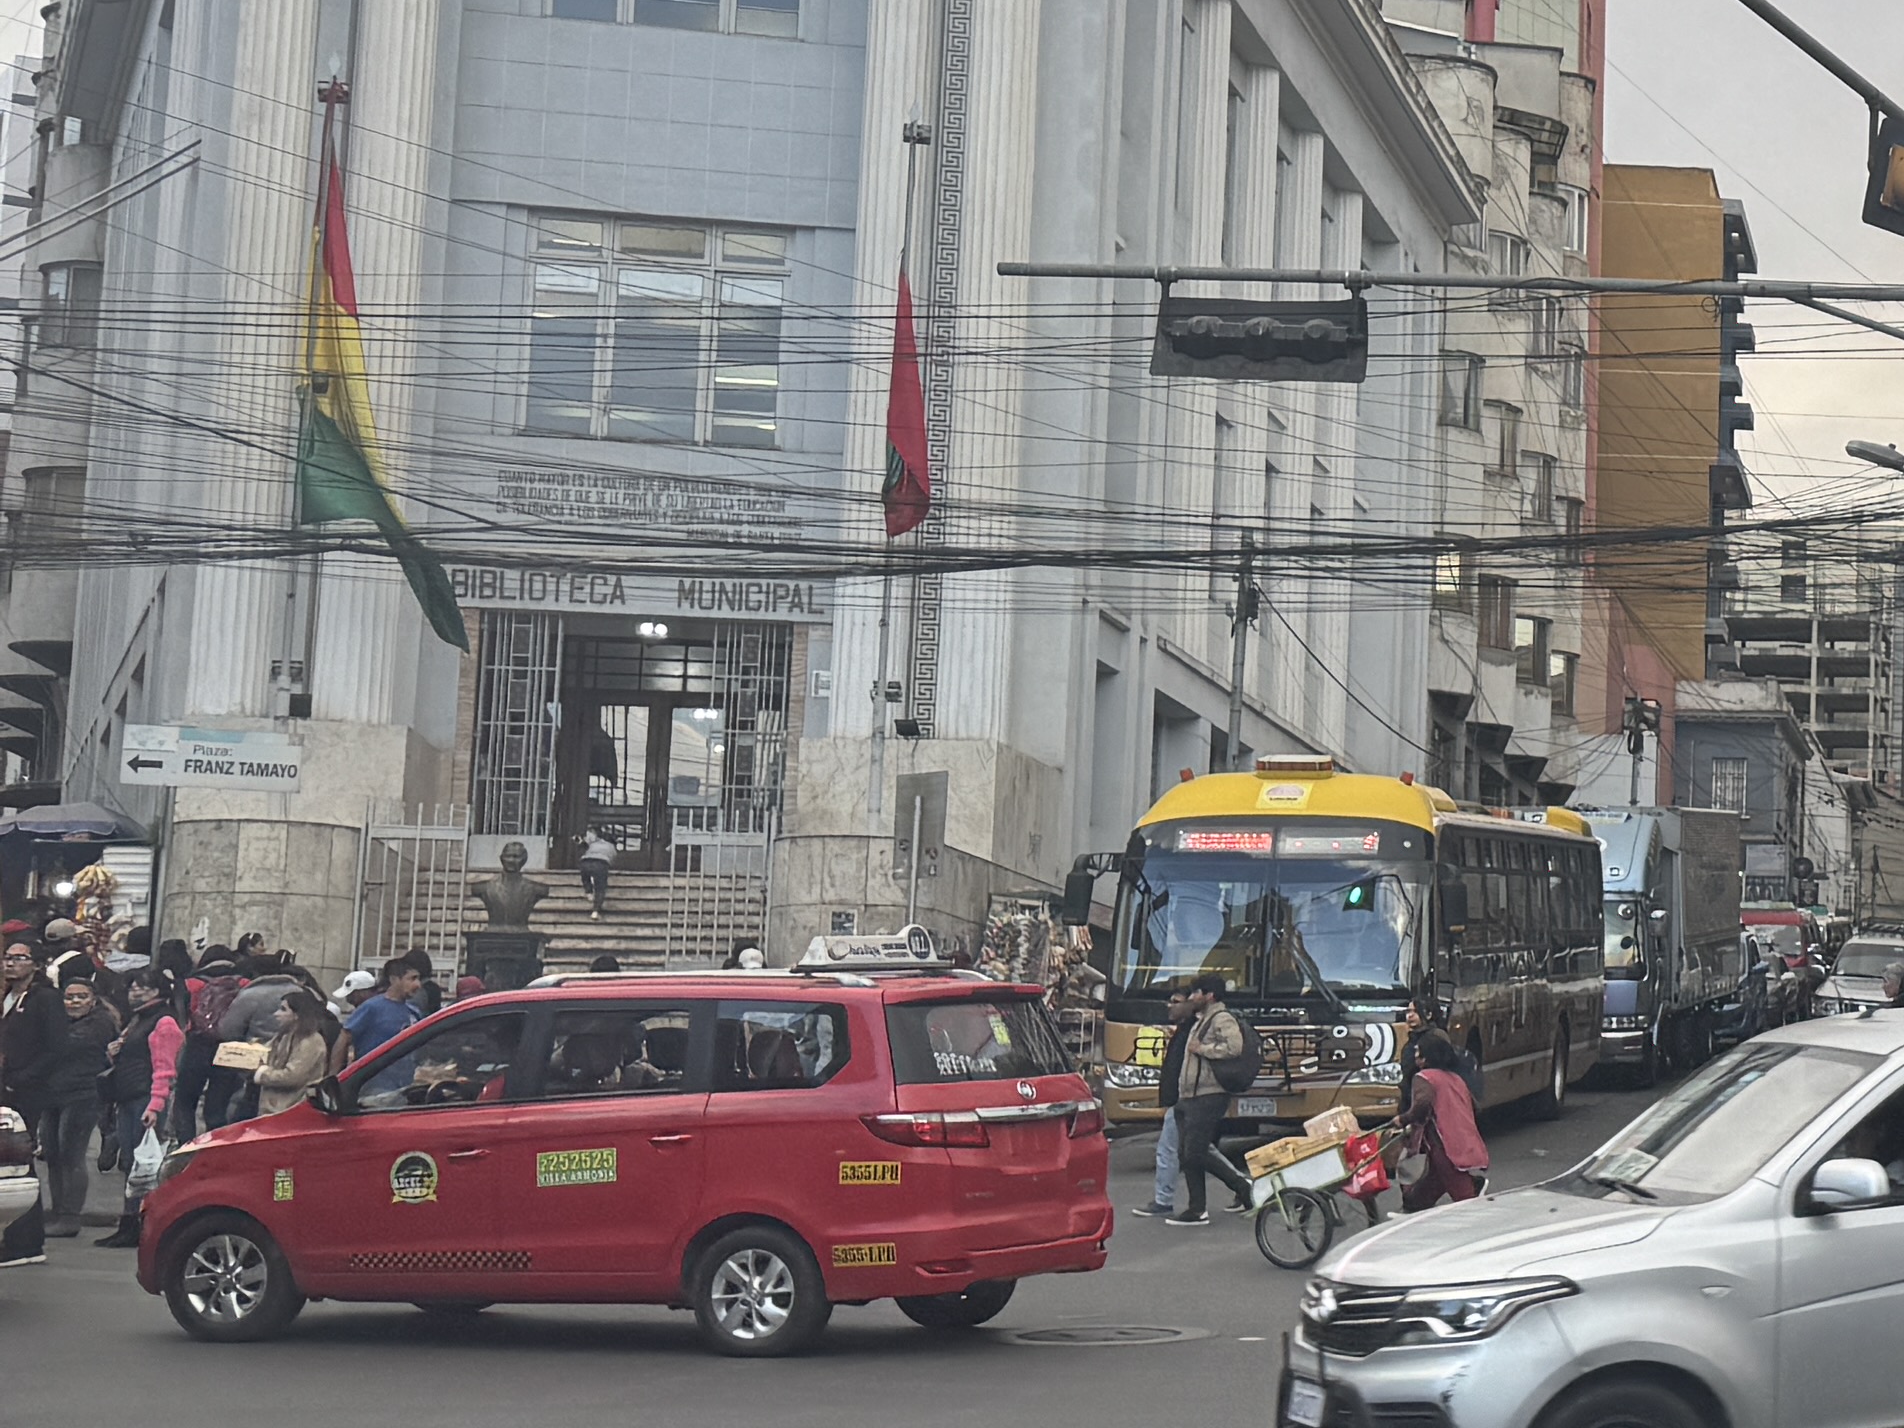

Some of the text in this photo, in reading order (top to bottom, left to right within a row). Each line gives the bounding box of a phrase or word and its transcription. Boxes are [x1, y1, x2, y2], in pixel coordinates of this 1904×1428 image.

[453, 568, 825, 615] BIBLIOTECA MUNICIPAL
[192, 744, 233, 758] Plaza:
[183, 758, 298, 779] FRANZ TAMAYO
